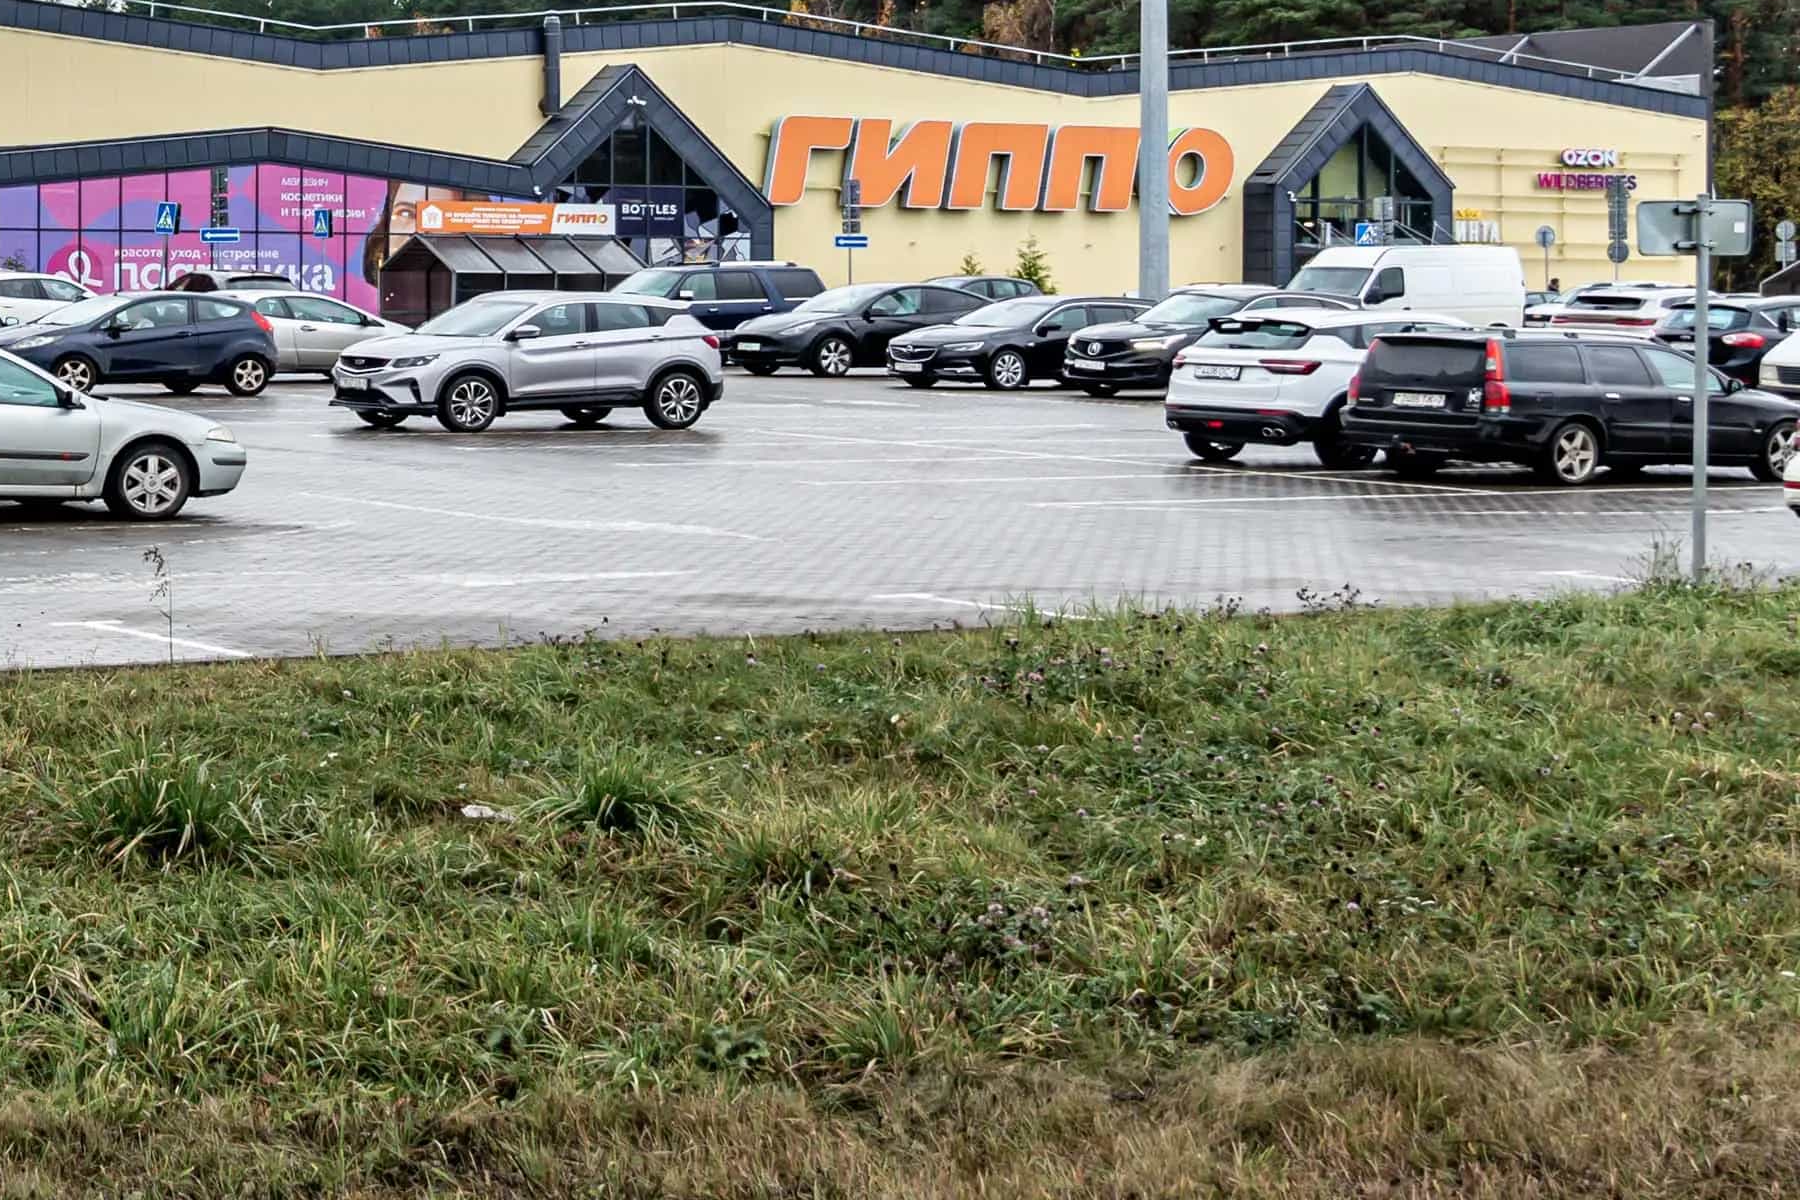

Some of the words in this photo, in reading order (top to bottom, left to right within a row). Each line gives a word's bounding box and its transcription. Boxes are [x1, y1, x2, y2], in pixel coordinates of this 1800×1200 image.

[1561, 149, 1618, 168] OZON
[766, 115, 1235, 217] ГИППО
[1536, 173, 1637, 191] WILDBERRS
[280, 192, 344, 203] косметики
[621, 203, 678, 216] BOTTLES
[557, 213, 608, 224] ГИППО
[170, 248, 200, 261] уход
